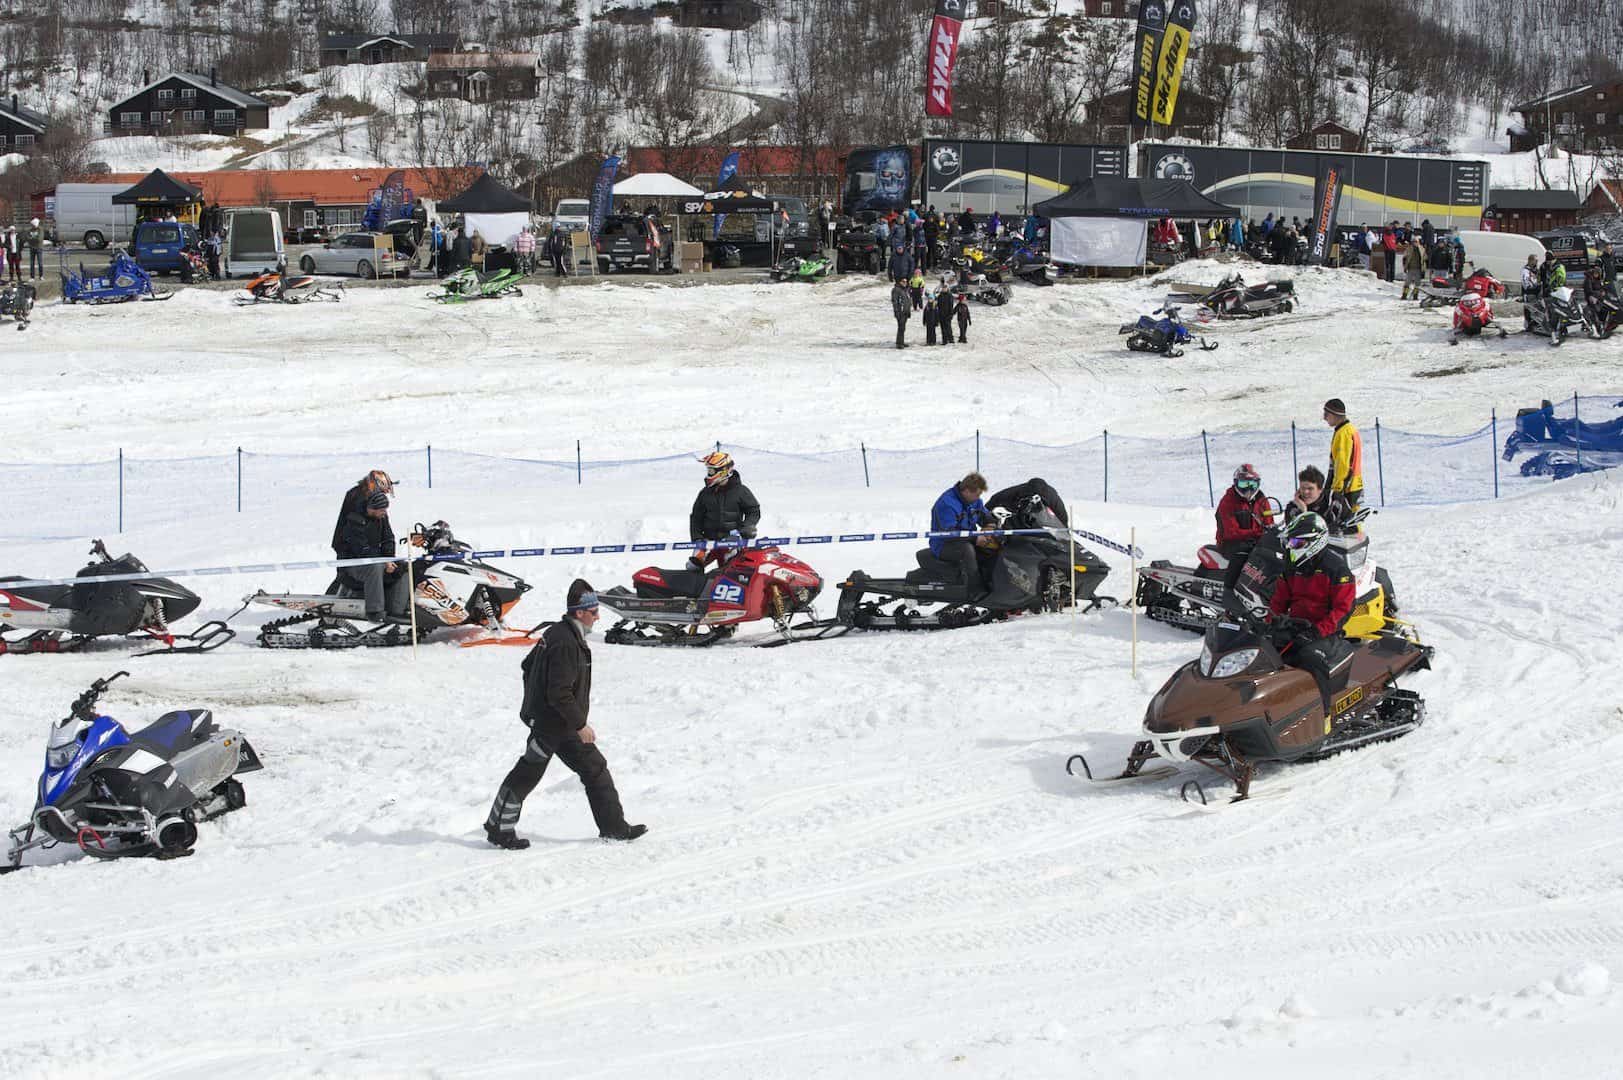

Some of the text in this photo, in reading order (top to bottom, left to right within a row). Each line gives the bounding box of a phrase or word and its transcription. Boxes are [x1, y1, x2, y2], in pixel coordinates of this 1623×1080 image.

[932, 24, 953, 109] LYNX
[1137, 34, 1154, 120] can-am
[1157, 31, 1182, 118] ski-doo
[712, 584, 742, 601] 92
